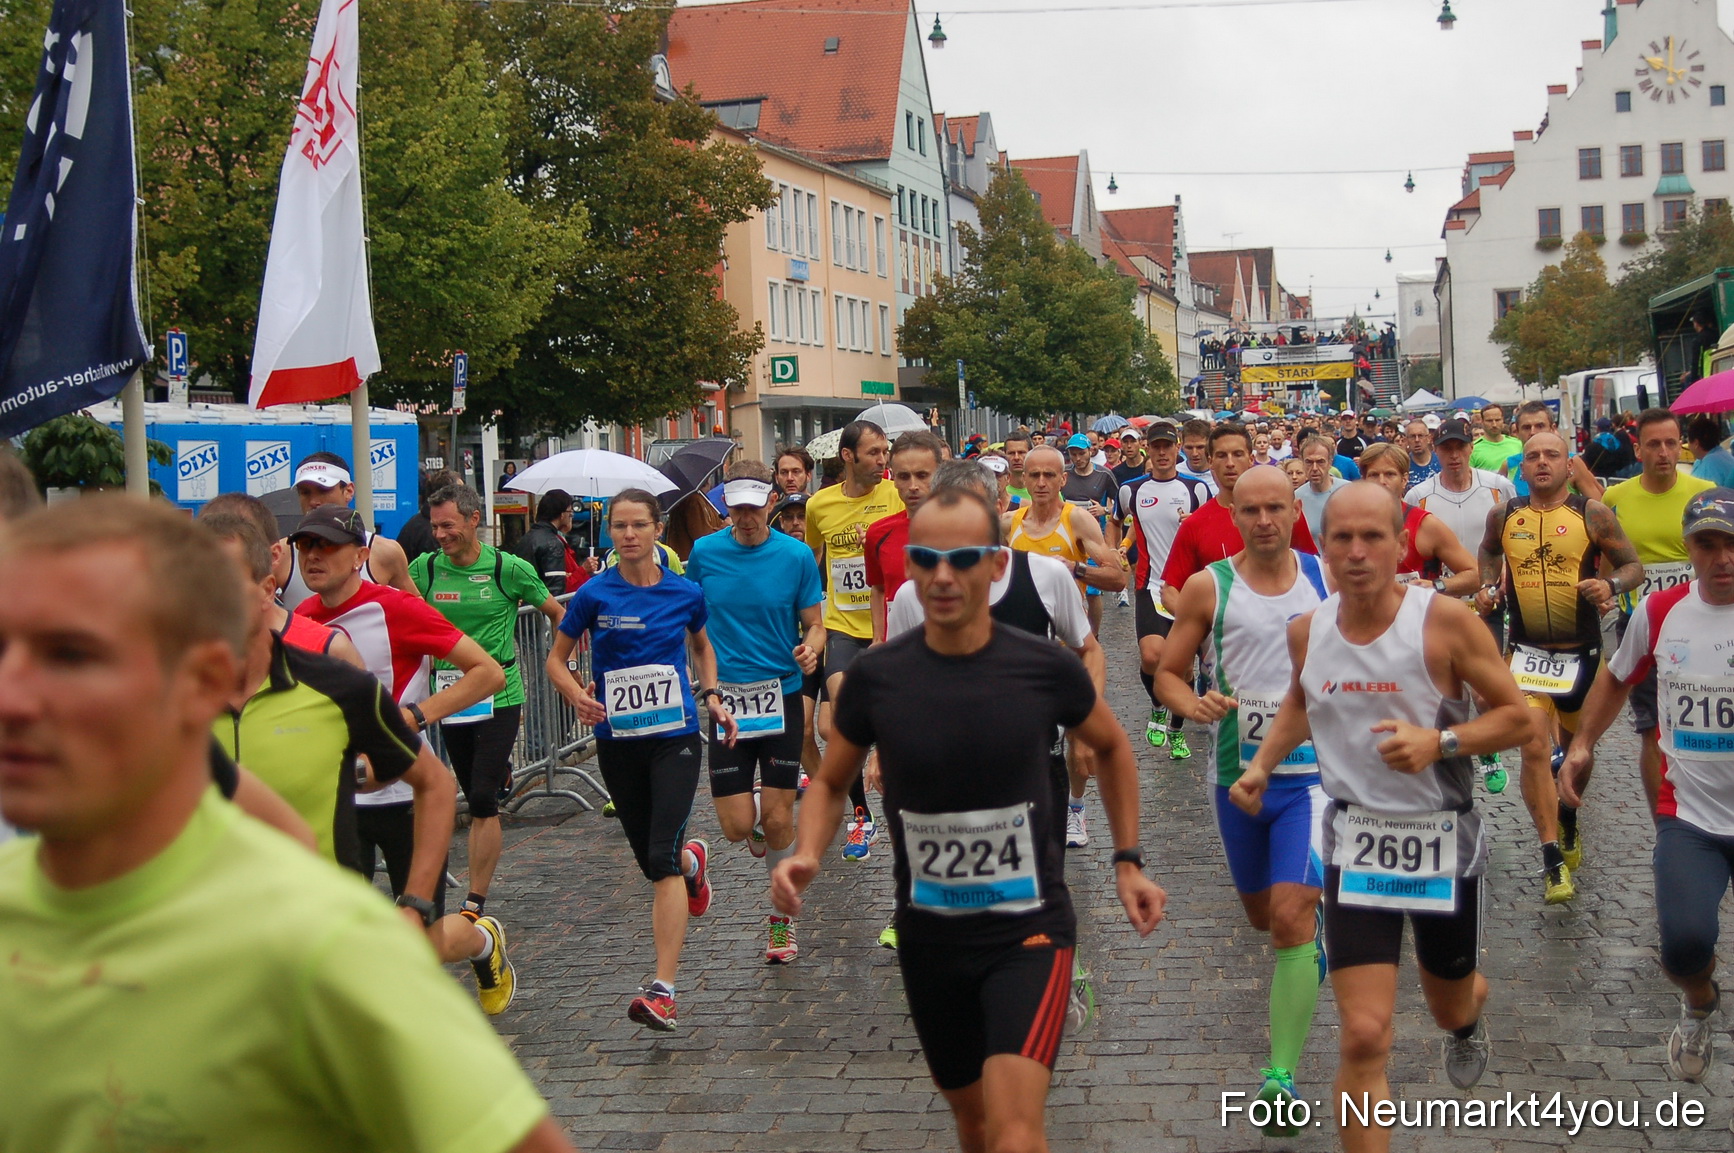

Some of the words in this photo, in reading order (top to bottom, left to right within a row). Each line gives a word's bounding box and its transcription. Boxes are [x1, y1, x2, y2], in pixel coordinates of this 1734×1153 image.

[172, 338, 183, 371] P
[457, 361, 465, 384] P
[775, 360, 794, 380] D
[1278, 367, 1316, 379] START
[842, 570, 867, 590] 43
[1524, 655, 1565, 677] 509
[606, 675, 628, 685] PARTL
[629, 671, 664, 682] Neumarkt
[1521, 676, 1559, 688] Christian
[718, 684, 737, 692] PARTL
[738, 684, 769, 693] Neumarkt
[1341, 682, 1403, 693] KLEBL
[1669, 682, 1699, 692] PARTL
[613, 679, 672, 713] 2047
[721, 691, 777, 716] 3112
[1240, 698, 1269, 709] PARTL
[633, 714, 660, 727] Birgit
[906, 821, 945, 835] PARTL
[948, 820, 1008, 834] Neumarkt
[1348, 814, 1382, 828] PARTL
[1384, 819, 1436, 831] Neumarkt
[918, 834, 1022, 878] 2224
[1353, 831, 1441, 872] 2691
[1366, 877, 1427, 894] Berthold
[941, 888, 1005, 904] Thomas
